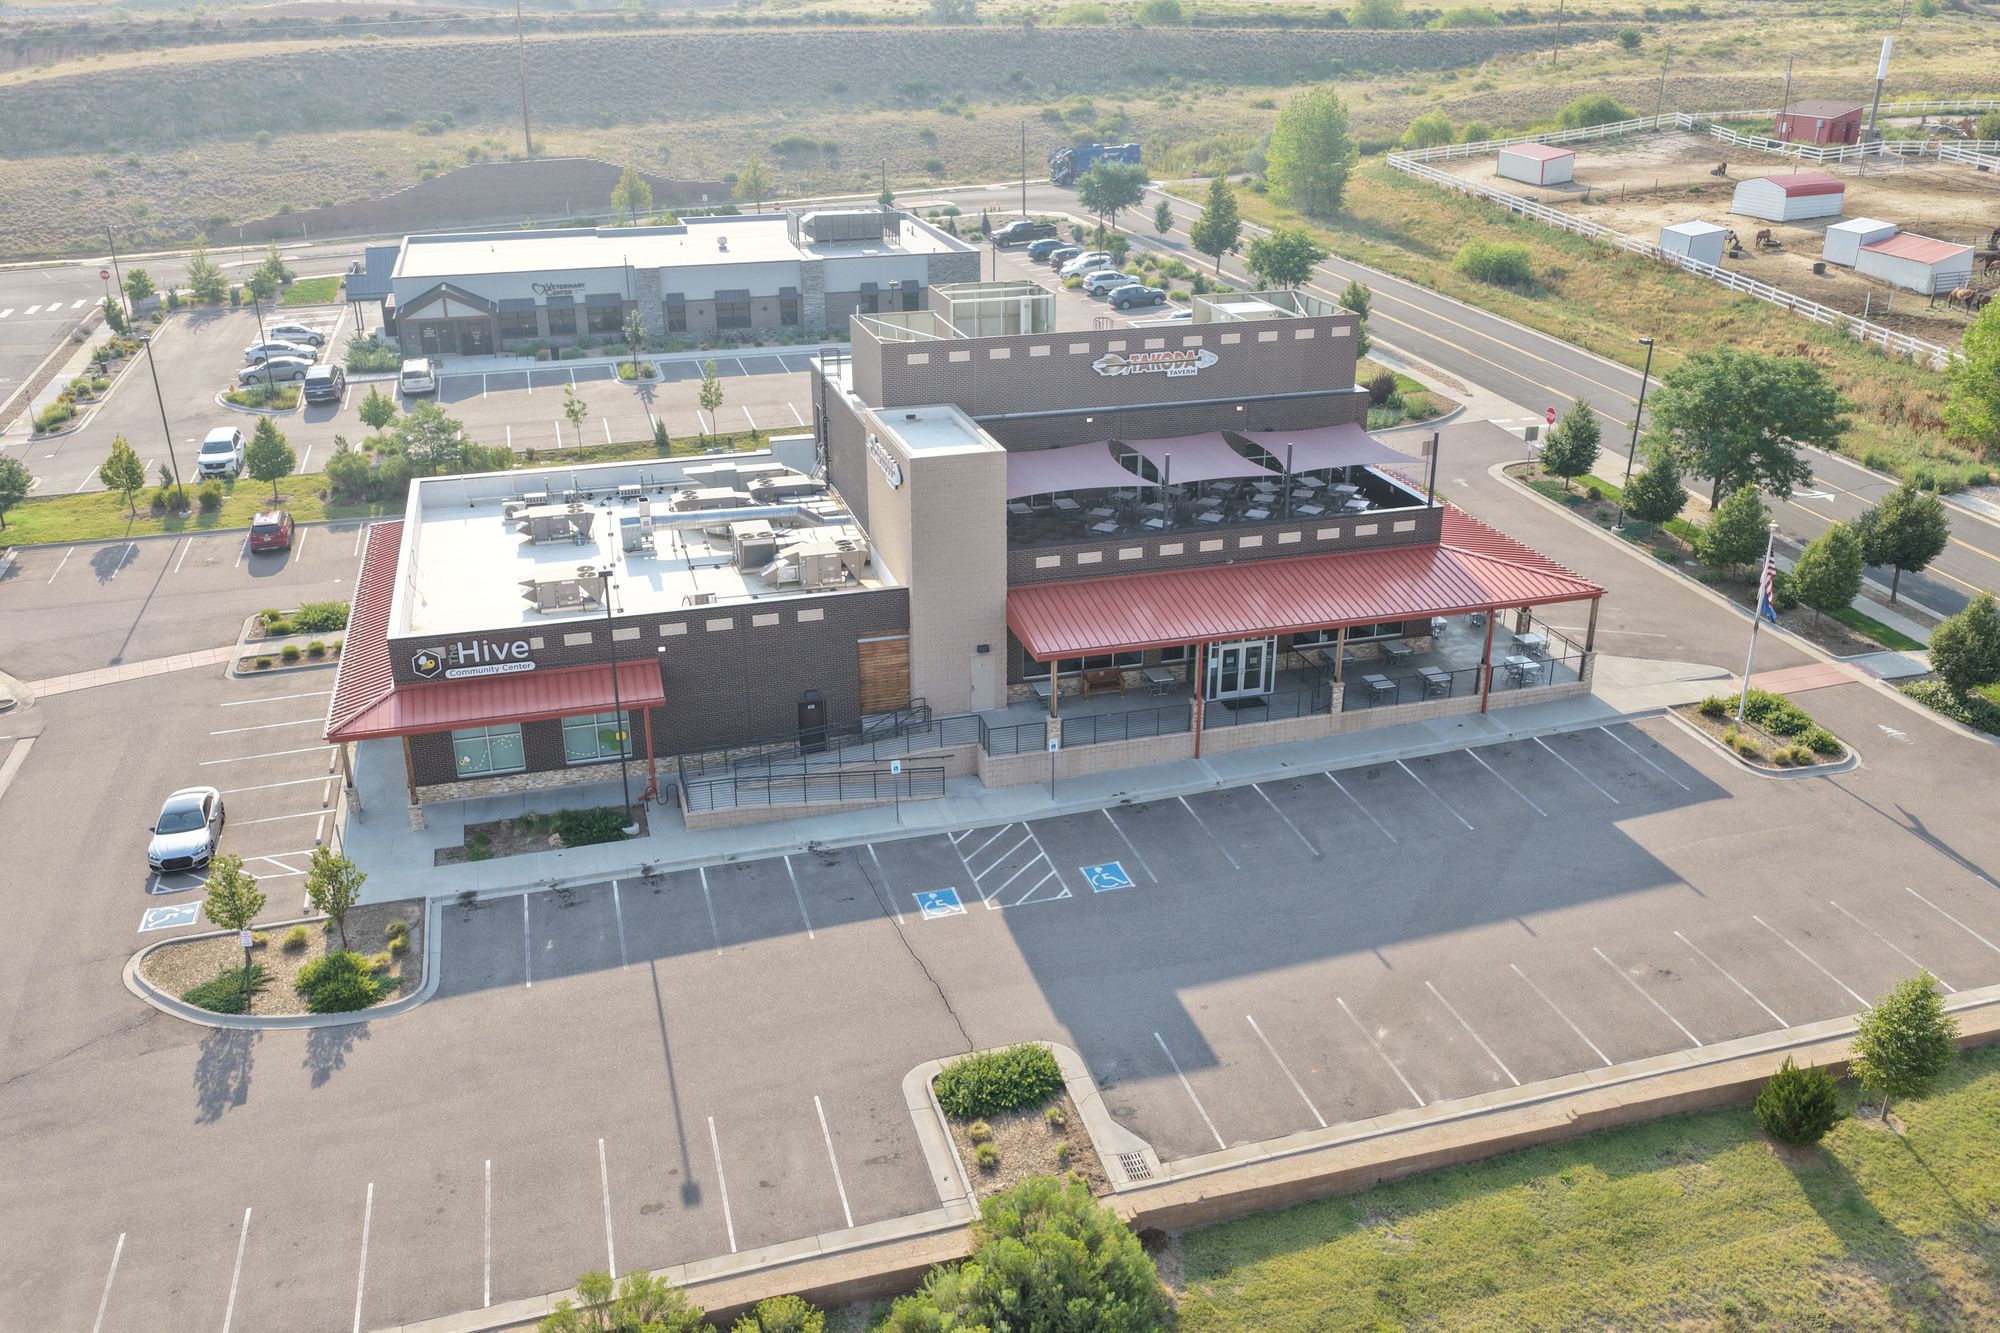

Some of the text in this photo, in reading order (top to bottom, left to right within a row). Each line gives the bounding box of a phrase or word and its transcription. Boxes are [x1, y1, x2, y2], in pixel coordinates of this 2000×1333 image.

[1130, 350, 1196, 372] TAKODA
[449, 643, 458, 664] The
[457, 640, 529, 664] Hive
[449, 662, 531, 677] Community Center
